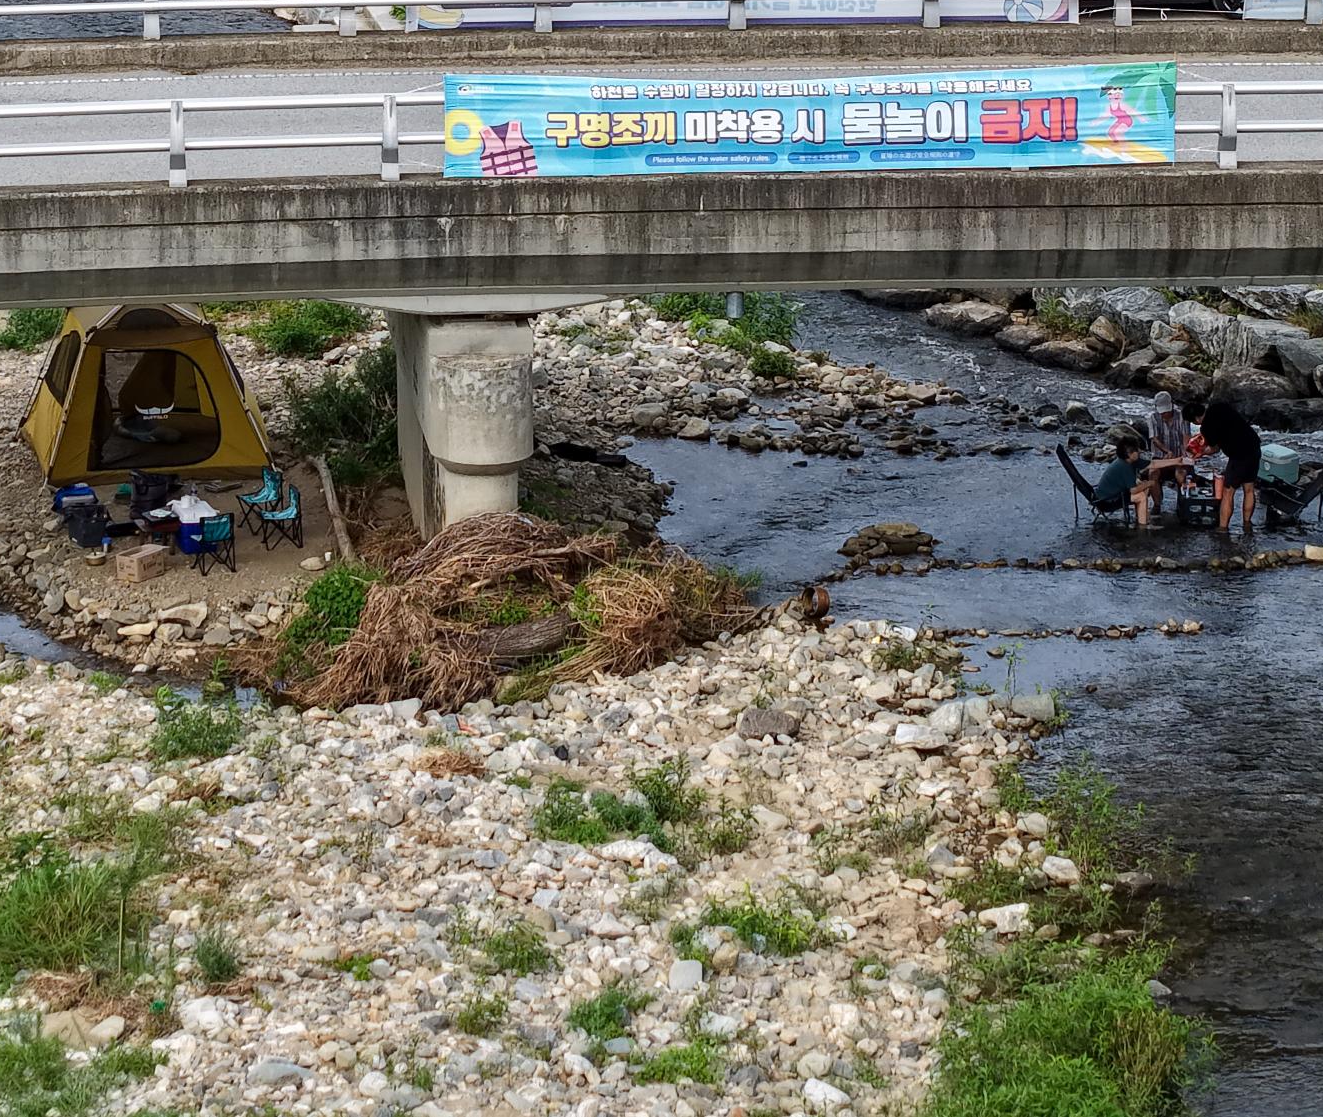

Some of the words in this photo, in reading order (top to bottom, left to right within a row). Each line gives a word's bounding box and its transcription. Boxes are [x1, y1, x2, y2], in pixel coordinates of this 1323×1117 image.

[590, 84, 639, 99] 하천은
[644, 84, 690, 99] 수심이
[695, 83, 756, 99] 일정하지
[855, 81, 933, 96] 구명조끼를
[937, 79, 1032, 95] 착용해주세요
[546, 110, 677, 149] 구명조끼
[684, 108, 784, 146] 미착용
[790, 109, 825, 145] 시
[842, 99, 969, 146] 물놀이
[980, 96, 1079, 144] 금지!
[676, 155, 696, 163] follow
[730, 155, 750, 163] safety
